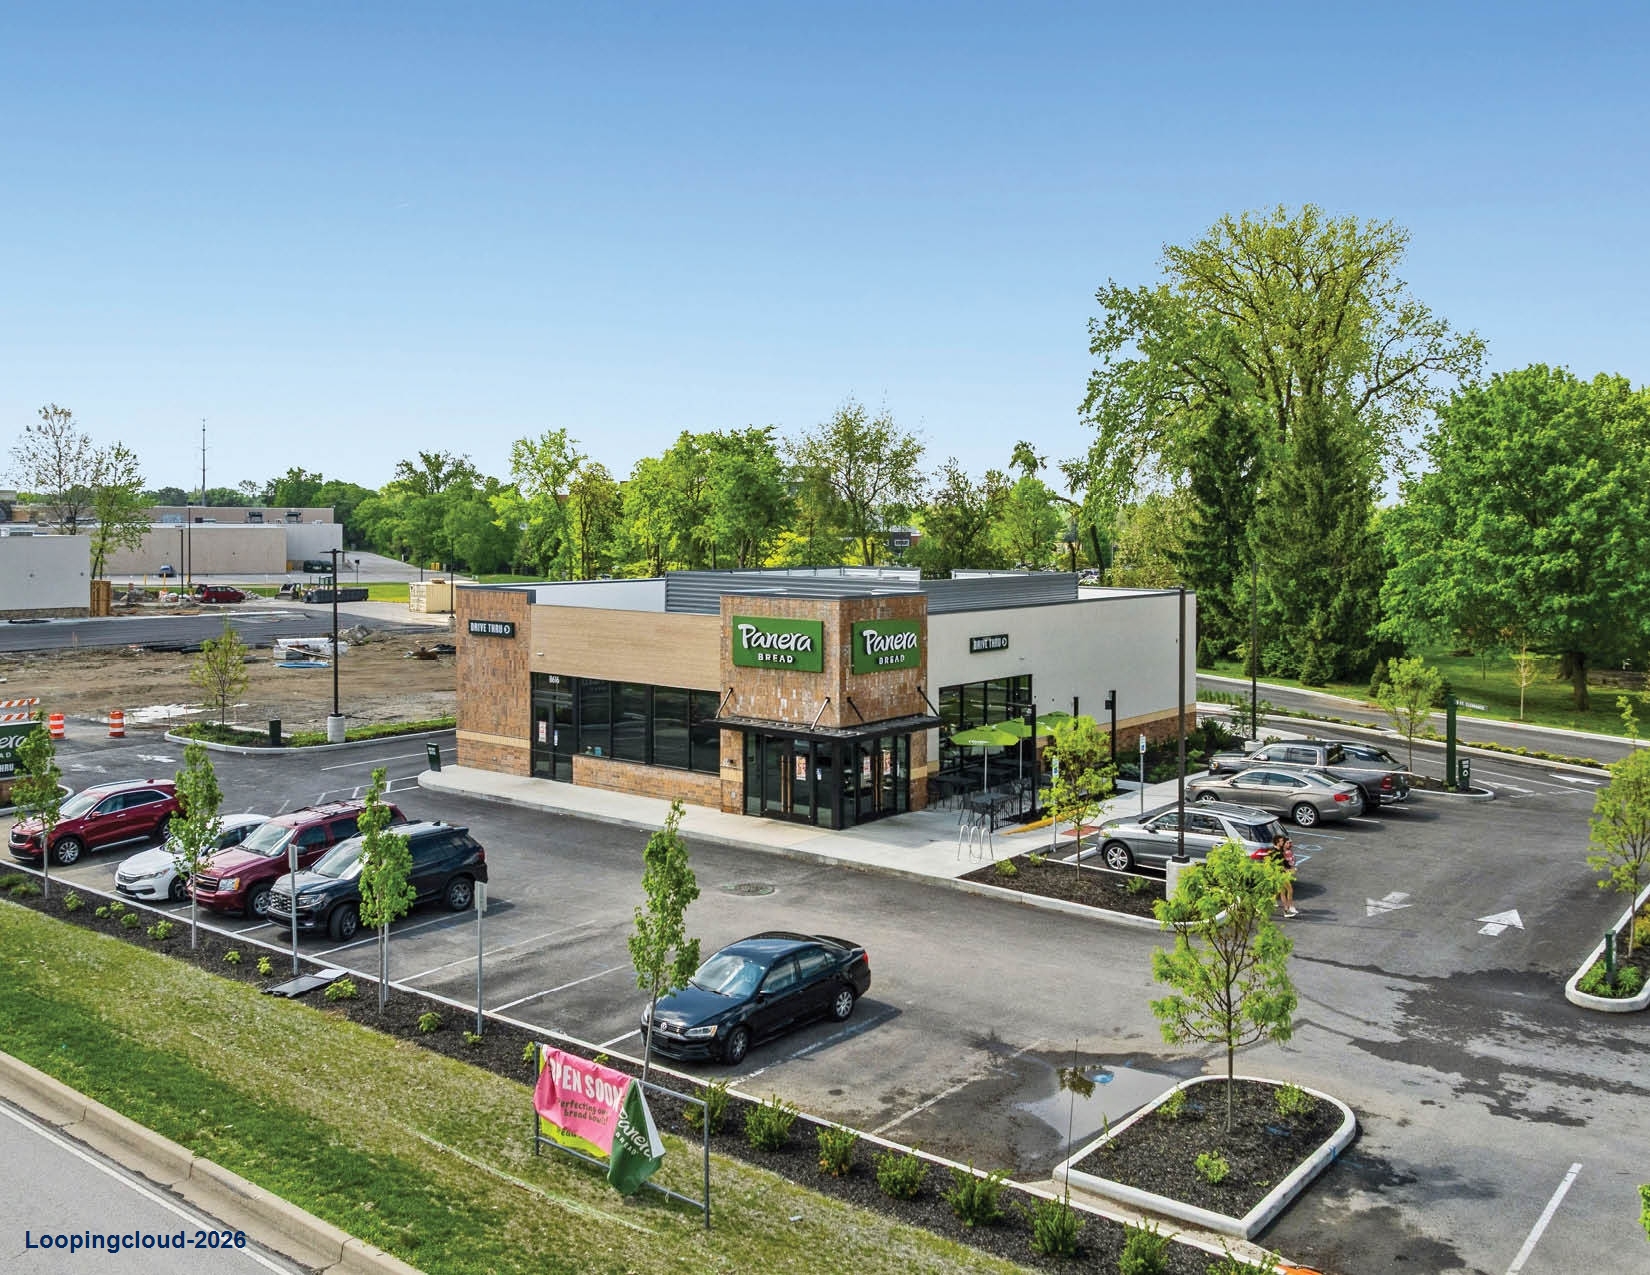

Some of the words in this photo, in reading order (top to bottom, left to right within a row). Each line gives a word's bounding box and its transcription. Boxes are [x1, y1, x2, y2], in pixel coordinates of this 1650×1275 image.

[470, 622, 487, 633] DRIVE
[488, 623, 503, 634] THRU
[738, 623, 812, 652] Panera
[863, 629, 918, 655] Panera
[758, 653, 794, 664] BREAD
[879, 654, 905, 665] BREAD
[558, 1098, 596, 1115] erfecting
